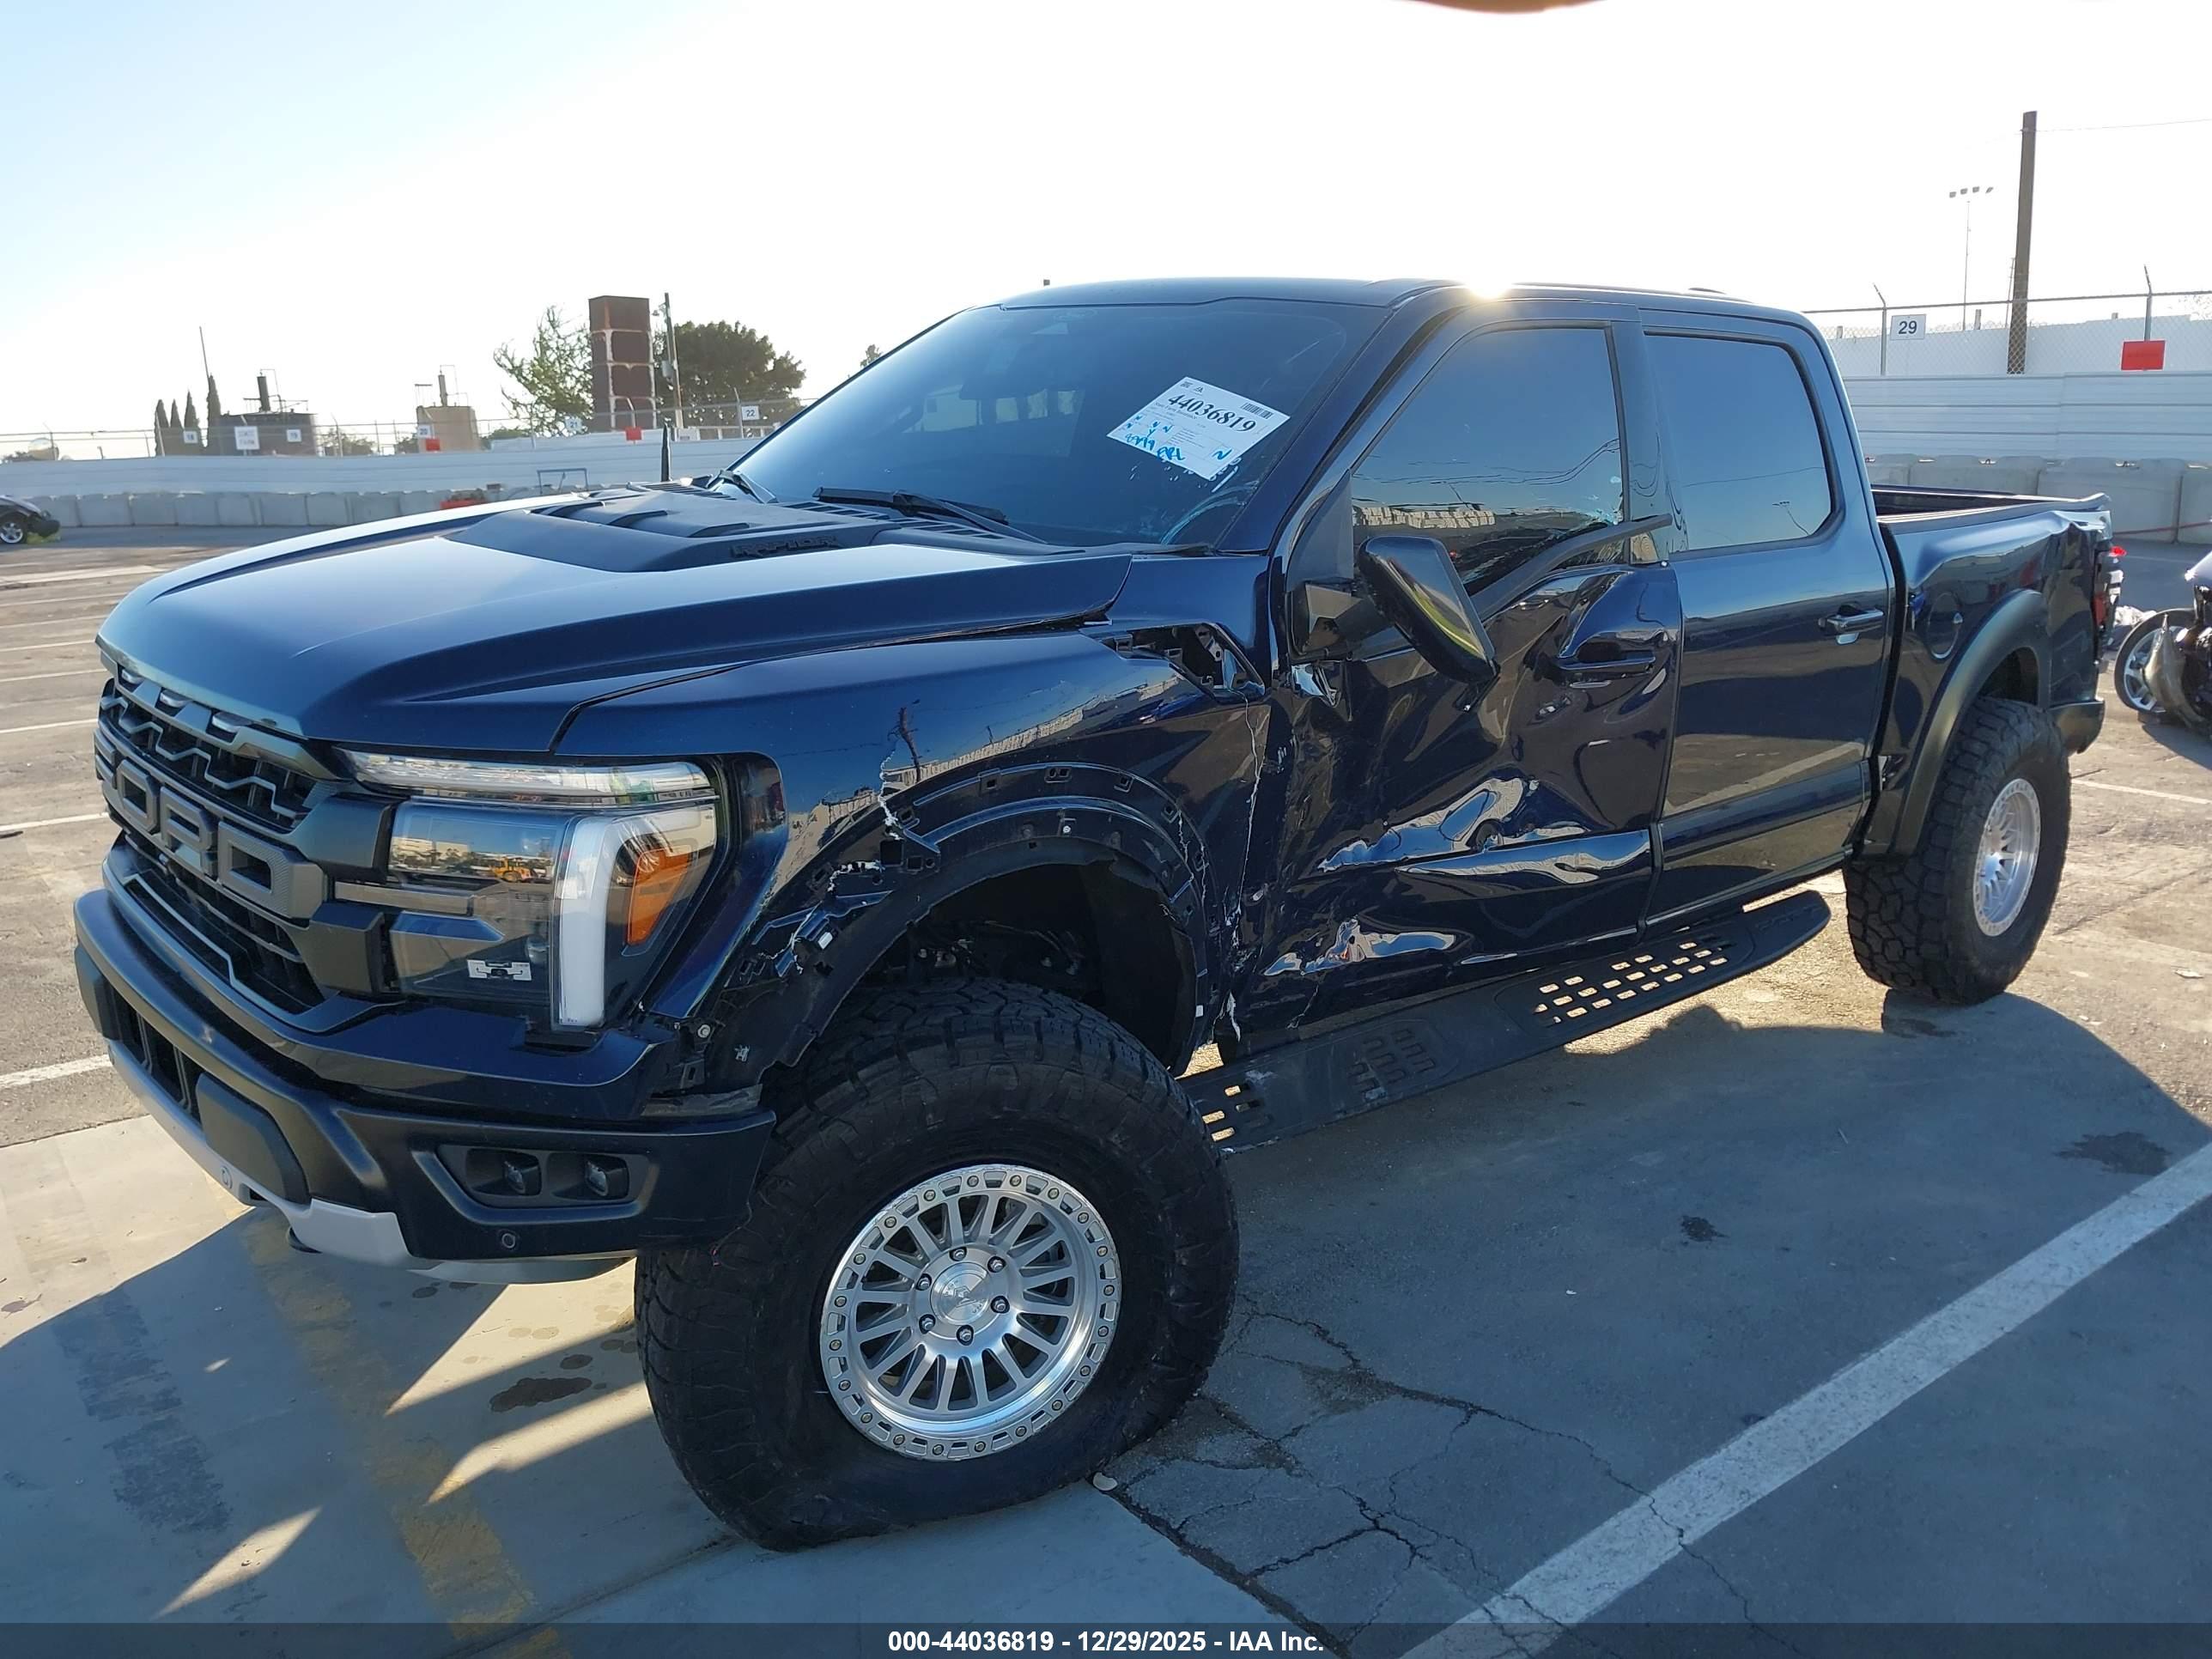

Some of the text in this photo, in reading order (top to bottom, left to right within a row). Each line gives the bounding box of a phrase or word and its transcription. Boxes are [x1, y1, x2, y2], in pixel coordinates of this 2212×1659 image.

[1898, 320, 1917, 335] 29
[745, 409, 757, 417] 22
[1168, 394, 1257, 433] 44036819
